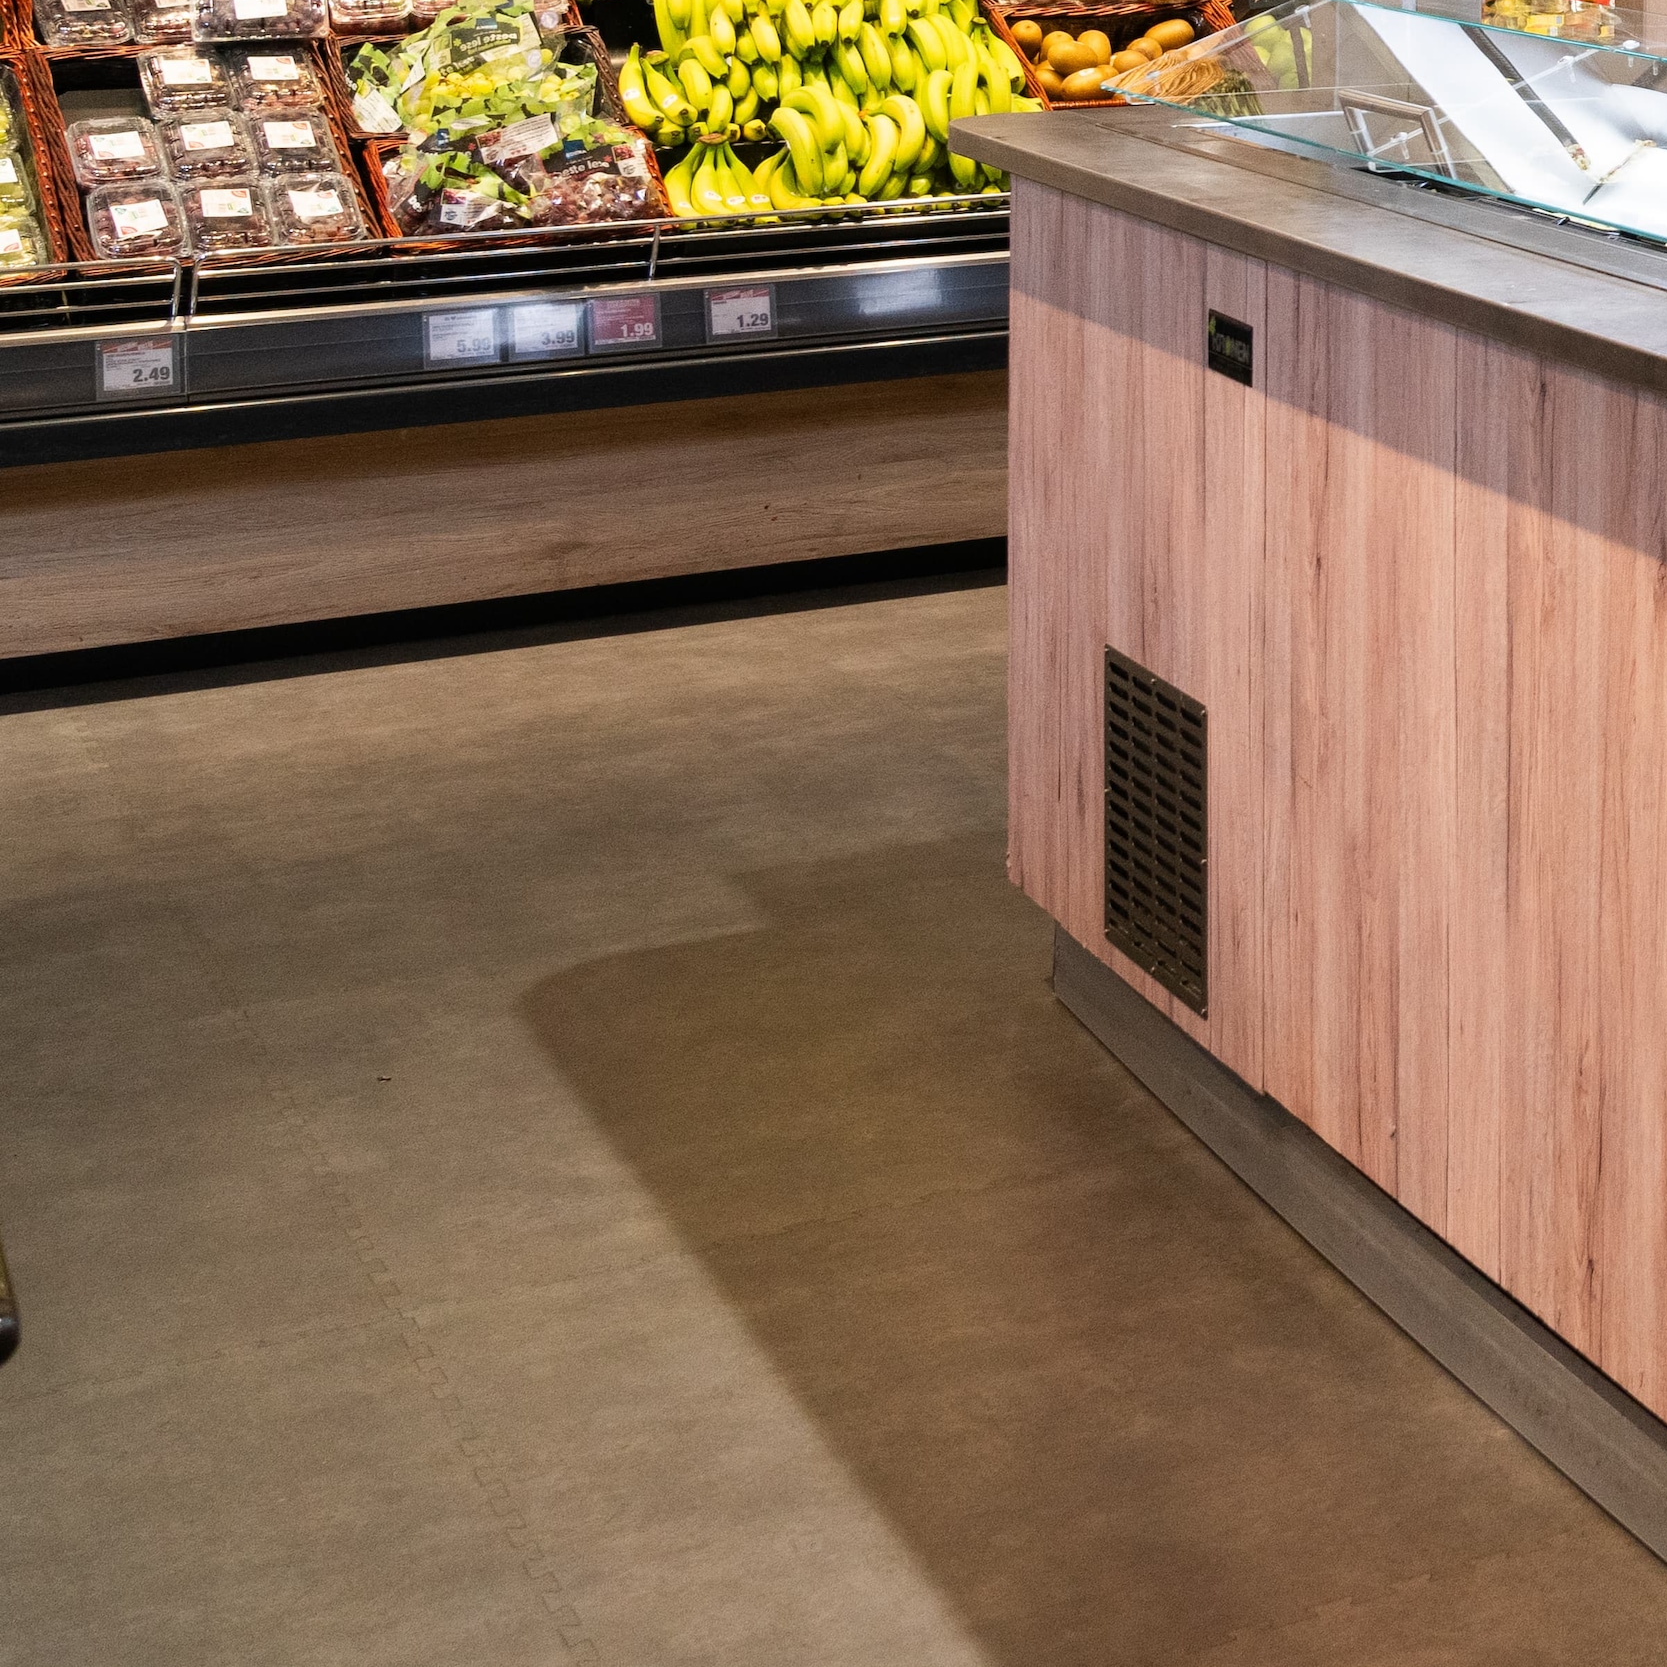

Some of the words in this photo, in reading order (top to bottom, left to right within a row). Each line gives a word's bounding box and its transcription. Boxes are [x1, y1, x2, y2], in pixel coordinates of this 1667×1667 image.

[736, 312, 769, 329] 1.29
[541, 330, 575, 346] 3.99
[620, 324, 654, 339] 1.99
[457, 337, 491, 353] 5.99
[131, 365, 171, 385] 2.49
